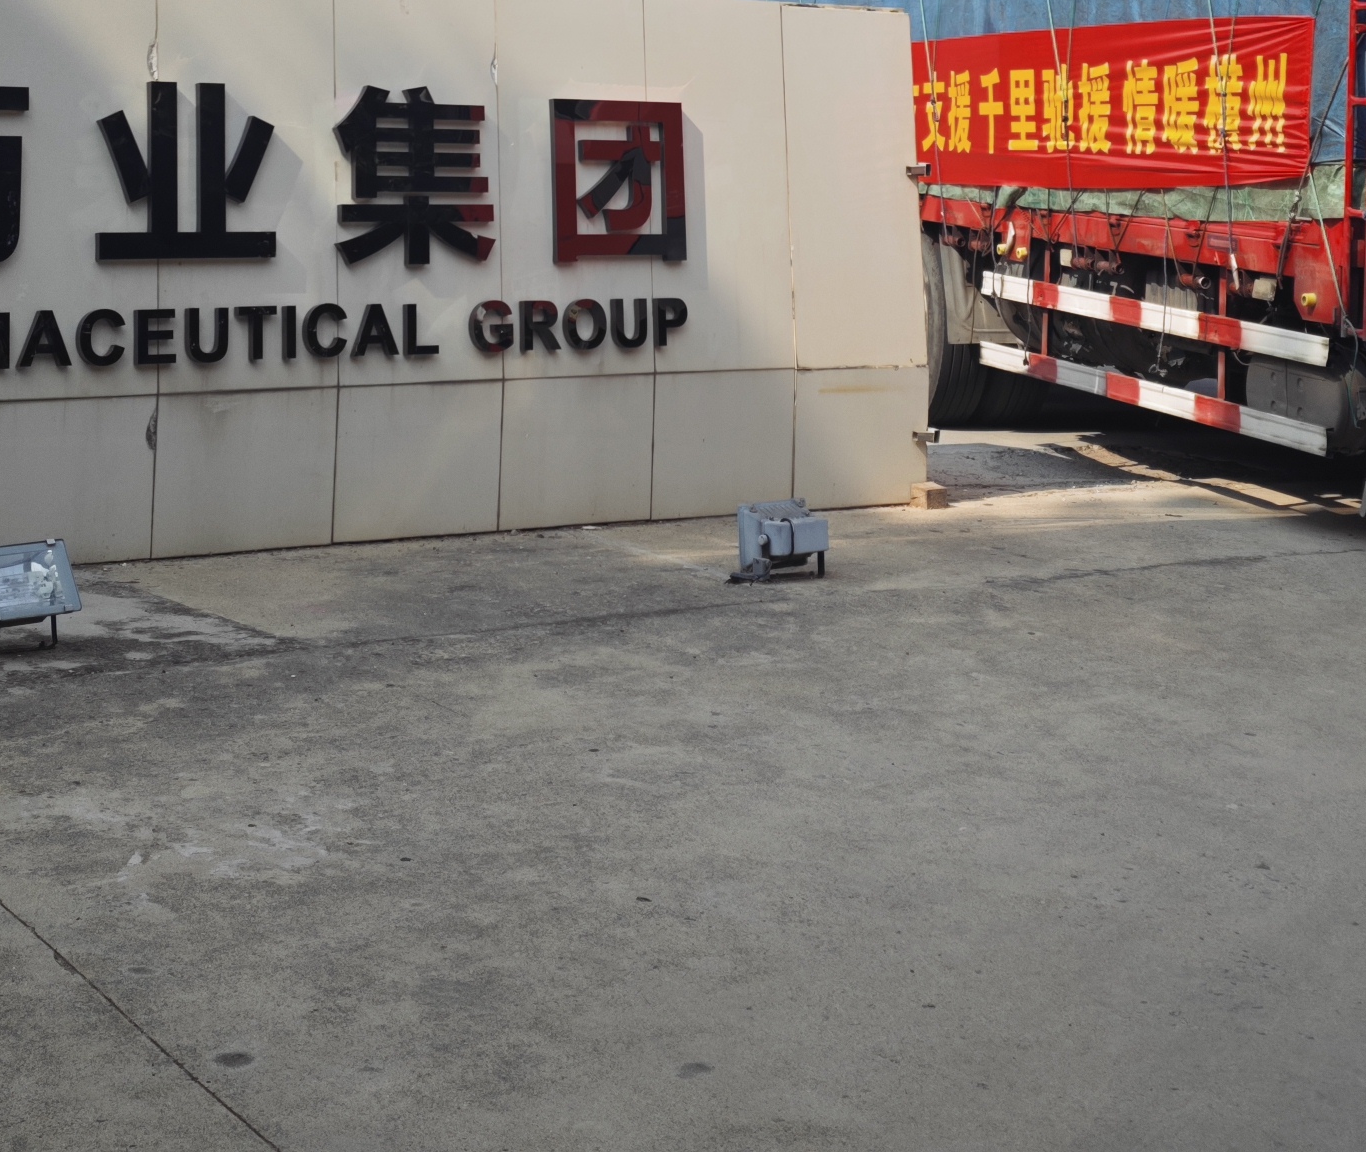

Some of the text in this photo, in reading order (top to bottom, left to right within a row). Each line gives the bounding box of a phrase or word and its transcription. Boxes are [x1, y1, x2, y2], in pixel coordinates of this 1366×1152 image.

[1123, 53, 1287, 155] 情暖横州
[468, 297, 689, 355] GROUP
